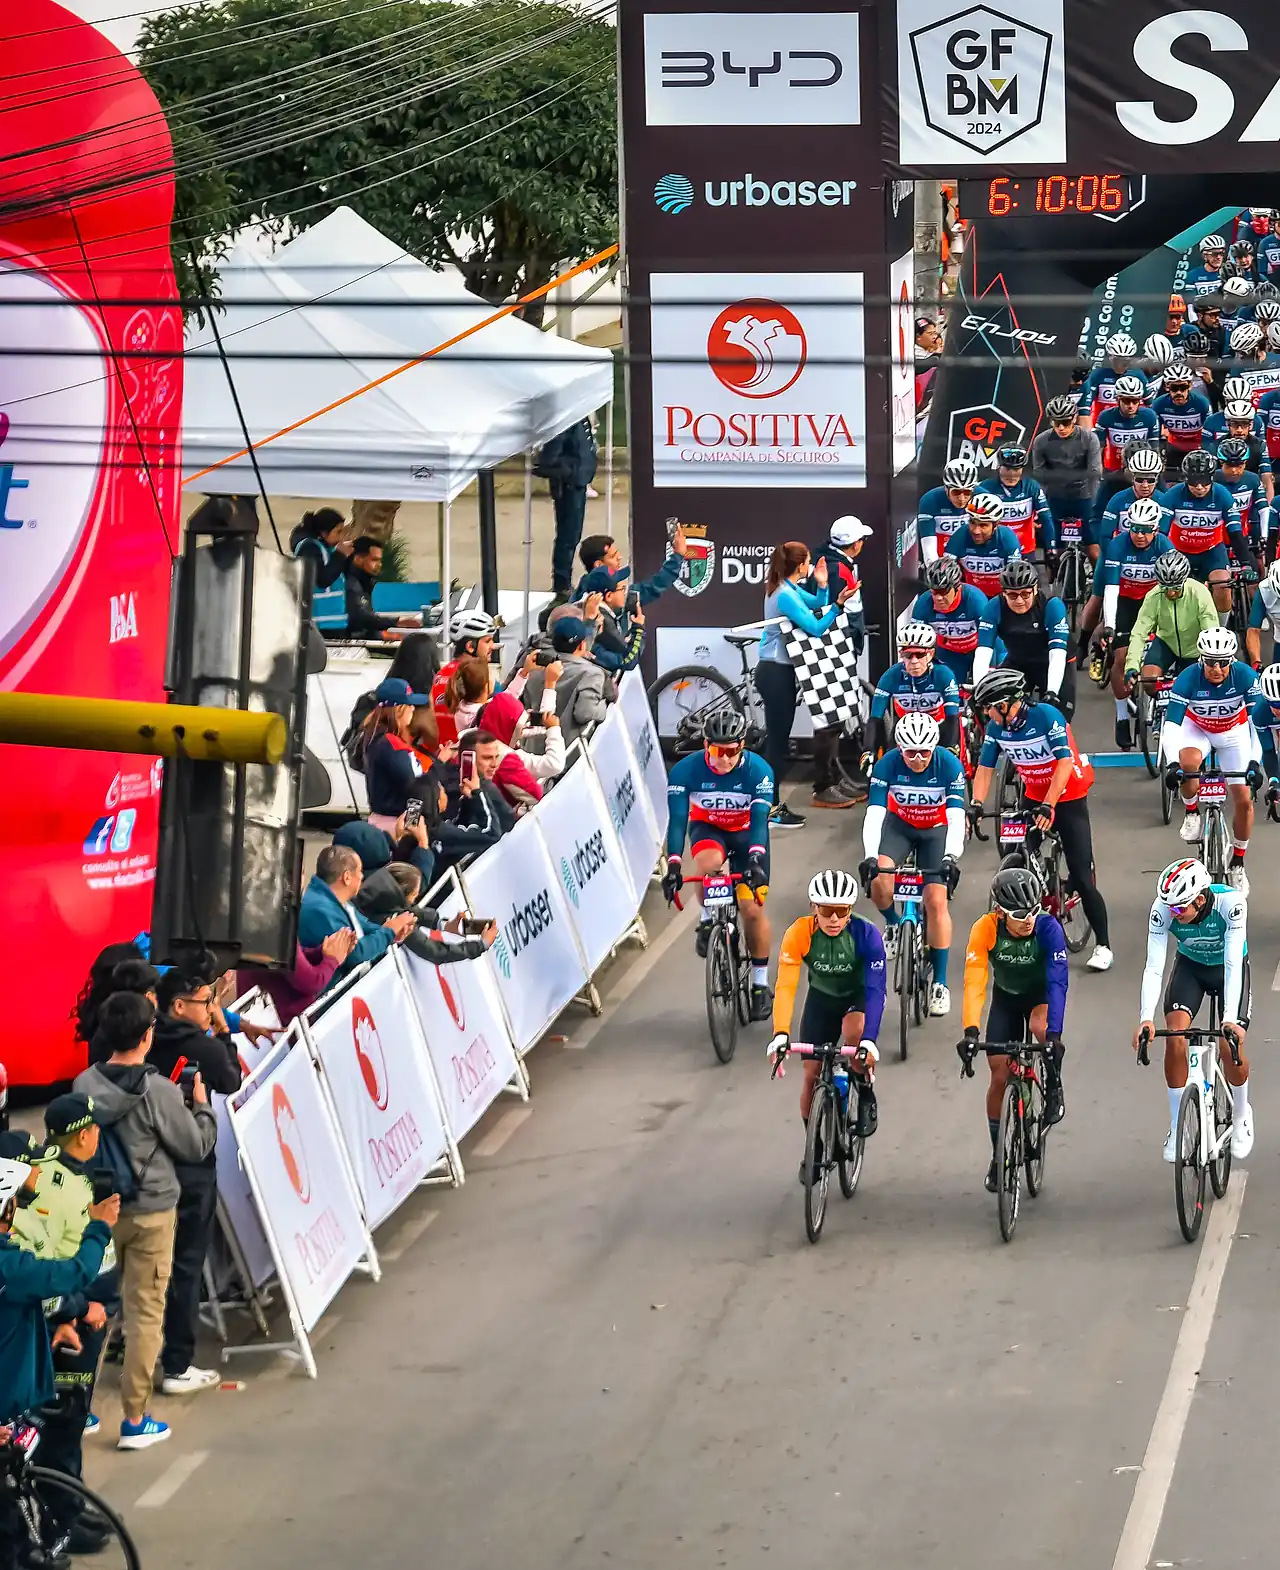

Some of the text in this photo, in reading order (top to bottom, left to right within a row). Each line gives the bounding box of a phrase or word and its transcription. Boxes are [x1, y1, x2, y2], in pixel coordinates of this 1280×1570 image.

[946, 29, 1016, 71] GF
[661, 51, 843, 88] BYD
[947, 74, 1018, 116] BM
[967, 122, 1003, 135] 2024
[705, 173, 857, 207] urbaser
[663, 405, 857, 448] POSITIVA
[965, 417, 1006, 440] GF
[776, 449, 840, 464] SEGUROS
[1179, 515, 1219, 527] GFBM
[1191, 703, 1243, 716] GFBM
[893, 790, 943, 805] GFBM
[1200, 785, 1225, 794] 2486
[571, 828, 610, 891] urbaser
[707, 886, 729, 896] 940
[899, 884, 919, 894] 673
[504, 884, 557, 957] urbaser
[368, 1108, 424, 1188] POSITIVA
